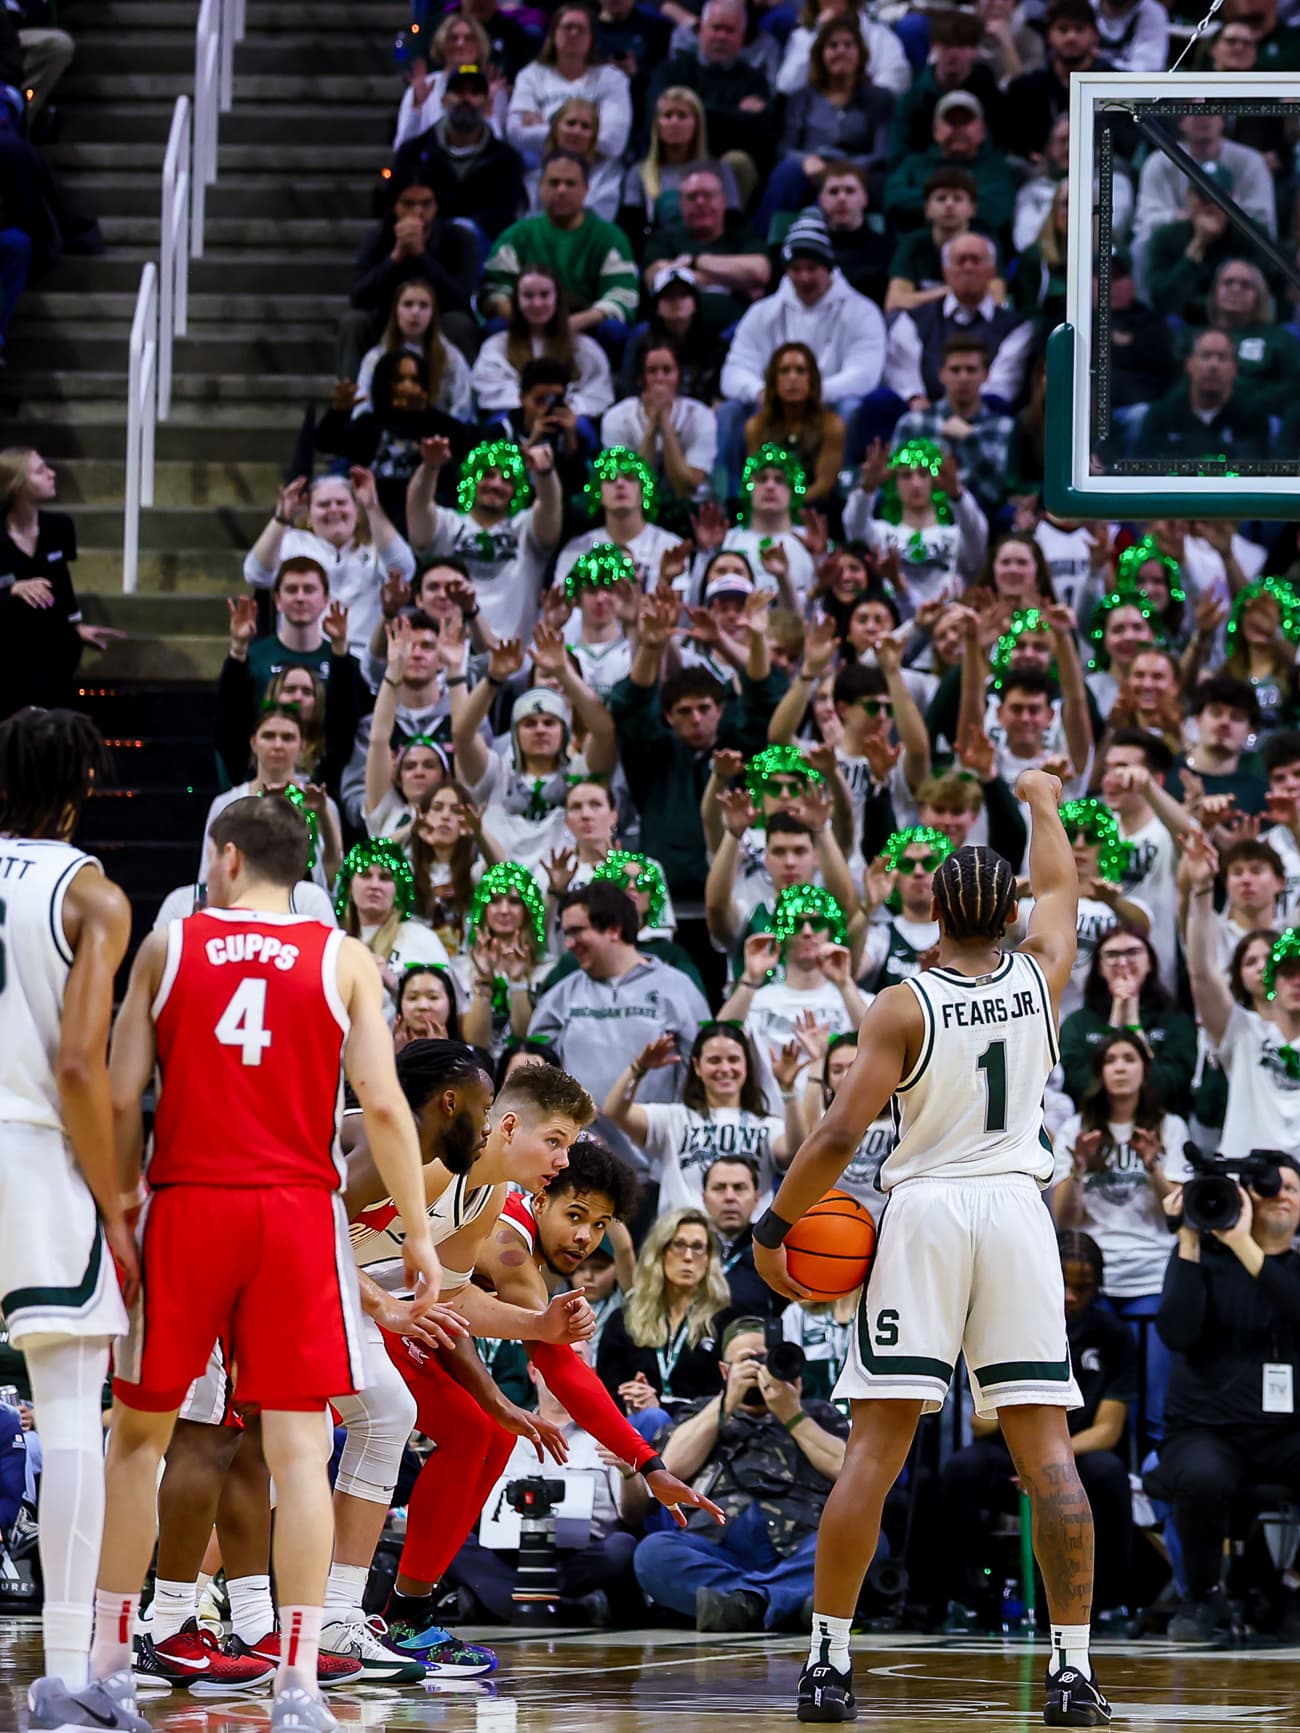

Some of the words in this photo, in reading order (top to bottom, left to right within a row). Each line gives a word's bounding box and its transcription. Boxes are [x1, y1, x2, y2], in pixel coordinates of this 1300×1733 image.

[0, 856, 37, 880] TT
[205, 933, 300, 972] CUPPS
[214, 978, 272, 1066] 4
[942, 998, 1007, 1028] FEARS
[1010, 989, 1040, 1019] JR.
[976, 1038, 1009, 1134] 1
[874, 1308, 899, 1346] S
[812, 1666, 831, 1678] GT
